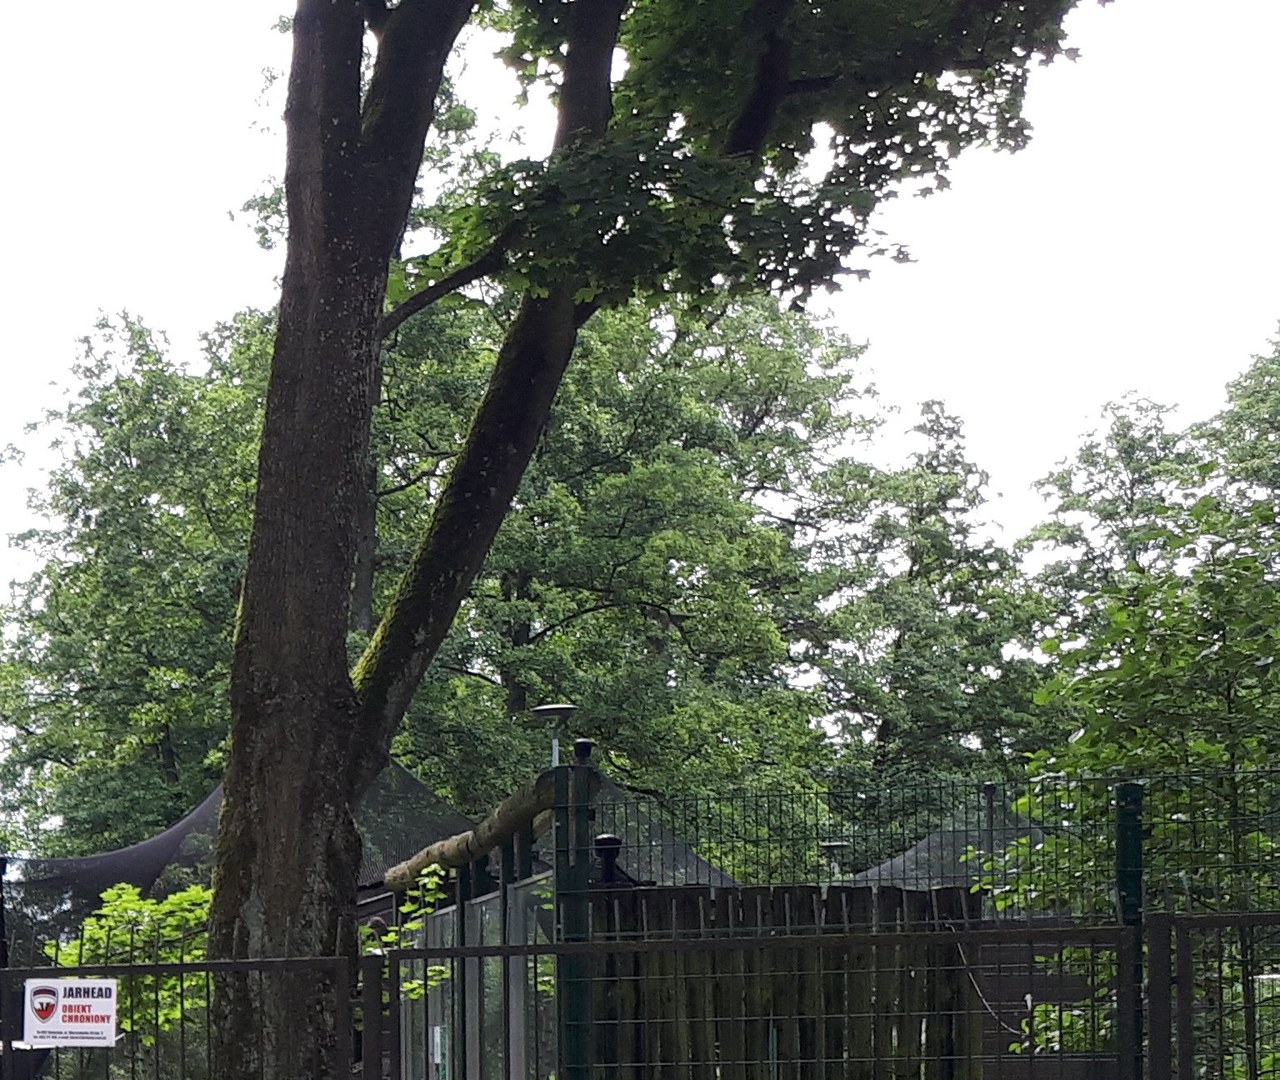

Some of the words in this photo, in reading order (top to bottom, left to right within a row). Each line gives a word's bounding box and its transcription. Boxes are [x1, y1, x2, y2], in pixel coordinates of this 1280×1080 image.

[62, 986, 112, 999] JARHEAD
[61, 1004, 92, 1013] OBIEKT
[61, 1014, 112, 1024] CHRONIONY
